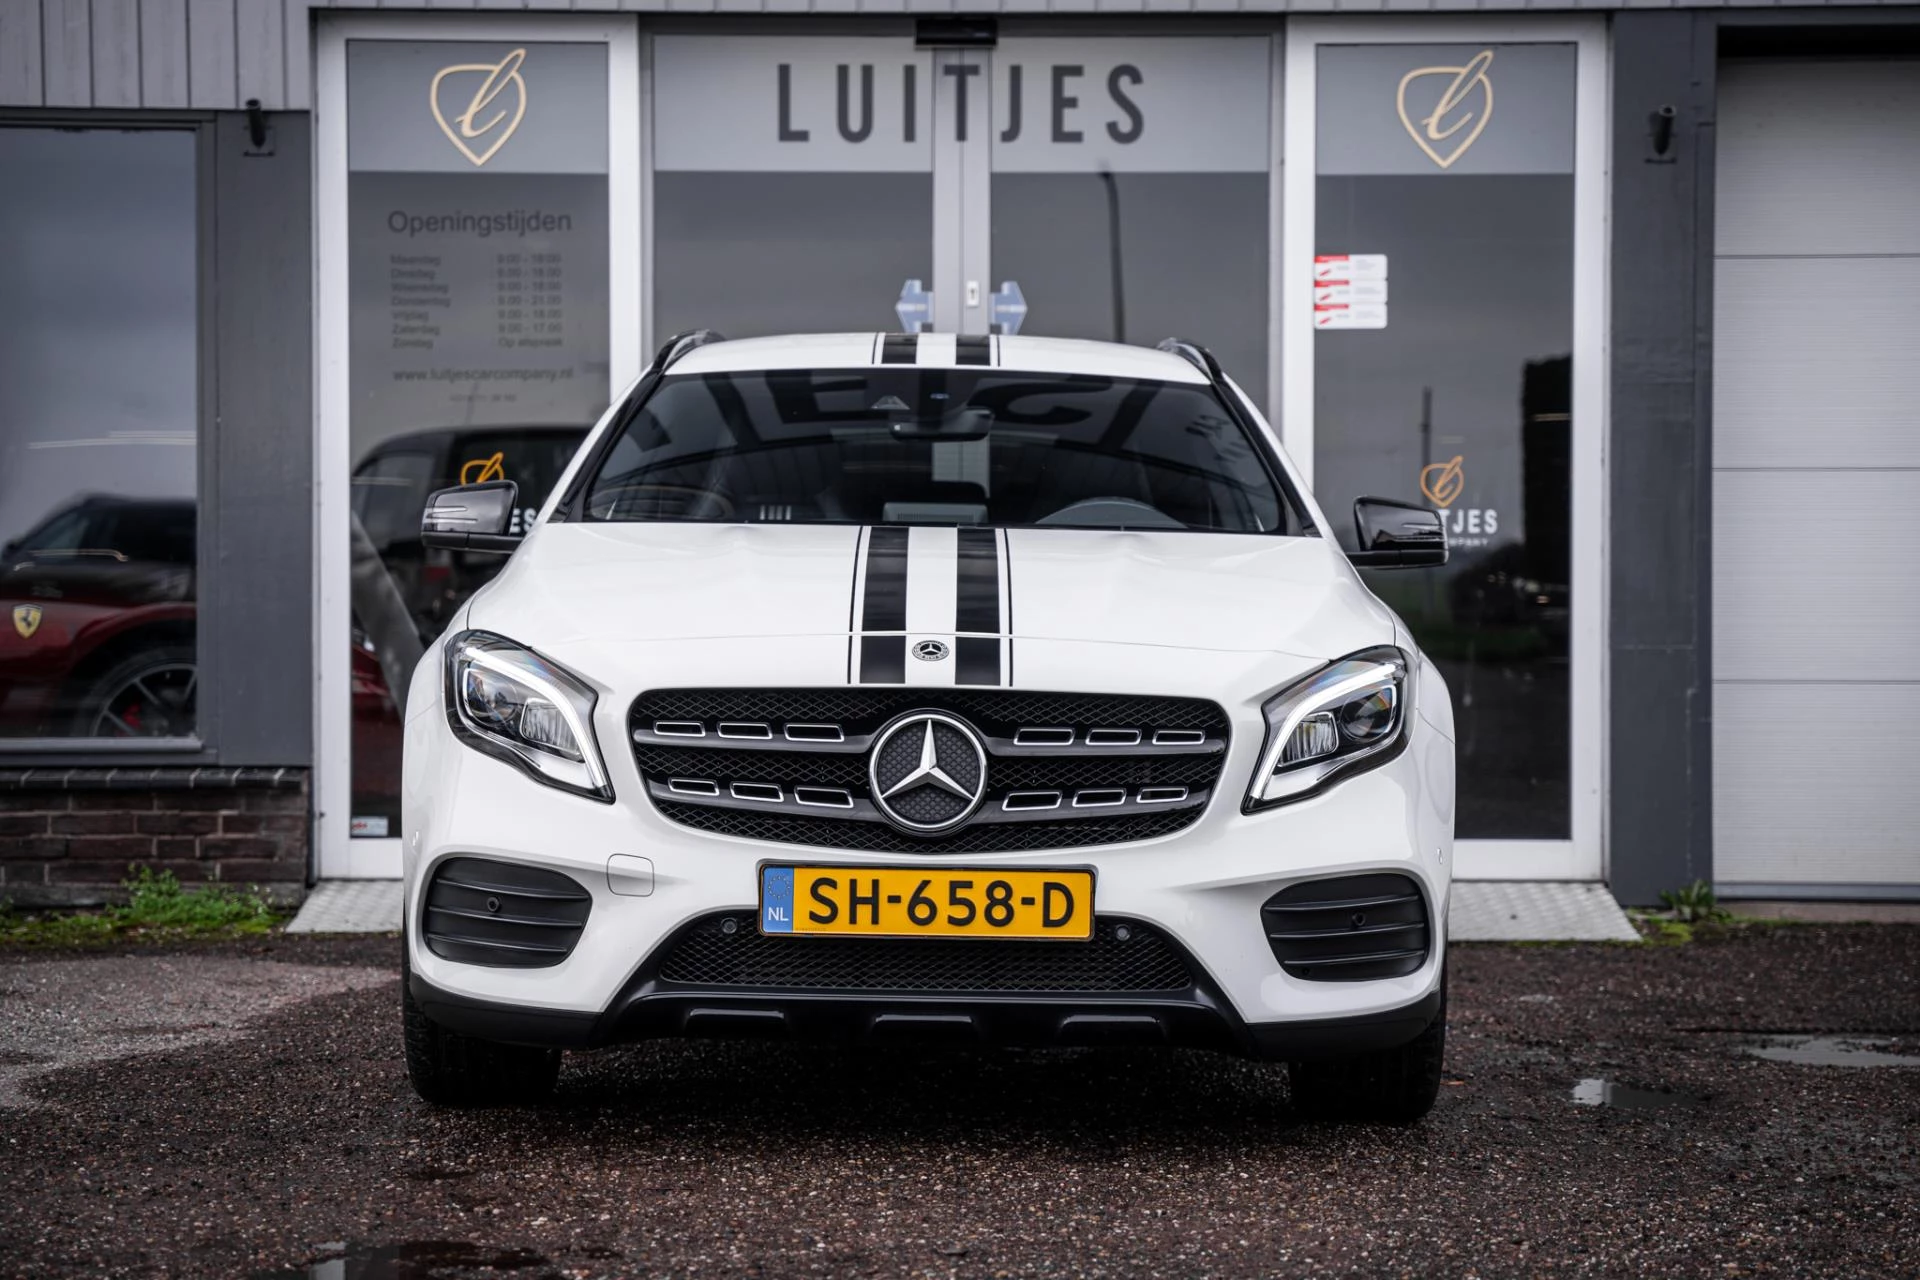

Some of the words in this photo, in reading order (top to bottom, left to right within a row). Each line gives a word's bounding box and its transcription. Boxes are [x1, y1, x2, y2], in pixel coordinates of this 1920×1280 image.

[778, 63, 1145, 145] LUITJES
[387, 209, 572, 237] Openingstijden
[1438, 508, 1498, 534] TJES
[767, 906, 790, 922] NL
[808, 875, 1075, 928] SH-658-D
